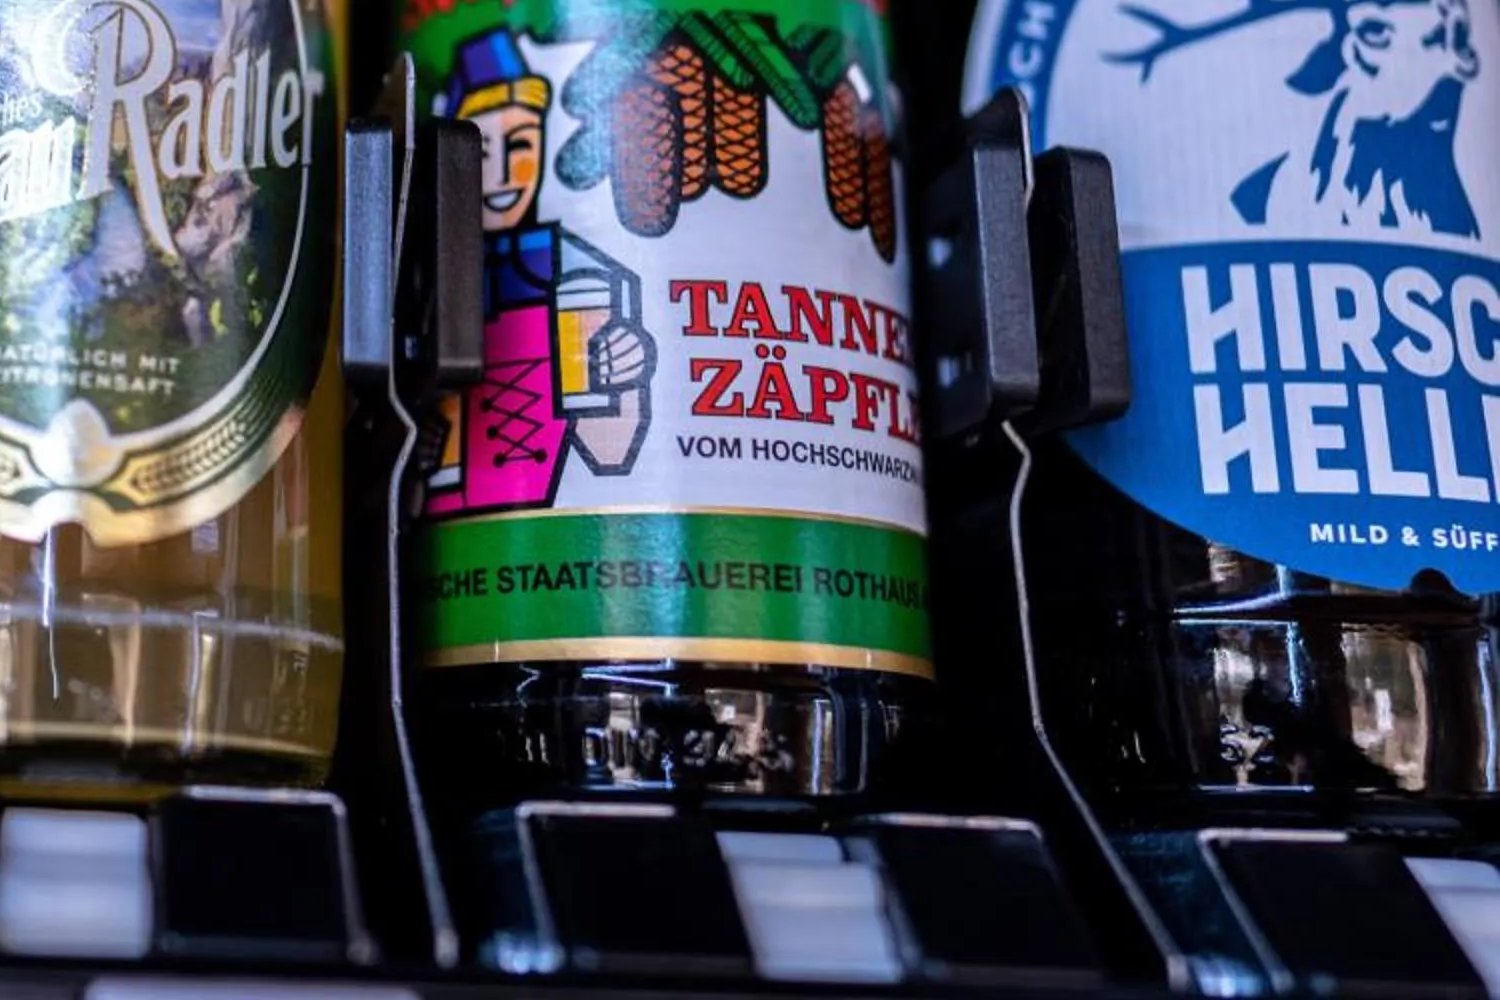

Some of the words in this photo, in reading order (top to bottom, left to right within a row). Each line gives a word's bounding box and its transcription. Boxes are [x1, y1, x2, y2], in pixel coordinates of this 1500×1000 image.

[1181, 261, 1500, 387] HIRSC
[138, 353, 180, 376] MIT
[678, 435, 744, 459] VOM
[1193, 382, 1500, 505] HELL
[1310, 523, 1389, 545] MILD
[1401, 525, 1420, 547] &
[1431, 523, 1499, 552] SÜFF
[496, 560, 803, 595] STAATSBRAUEREI
